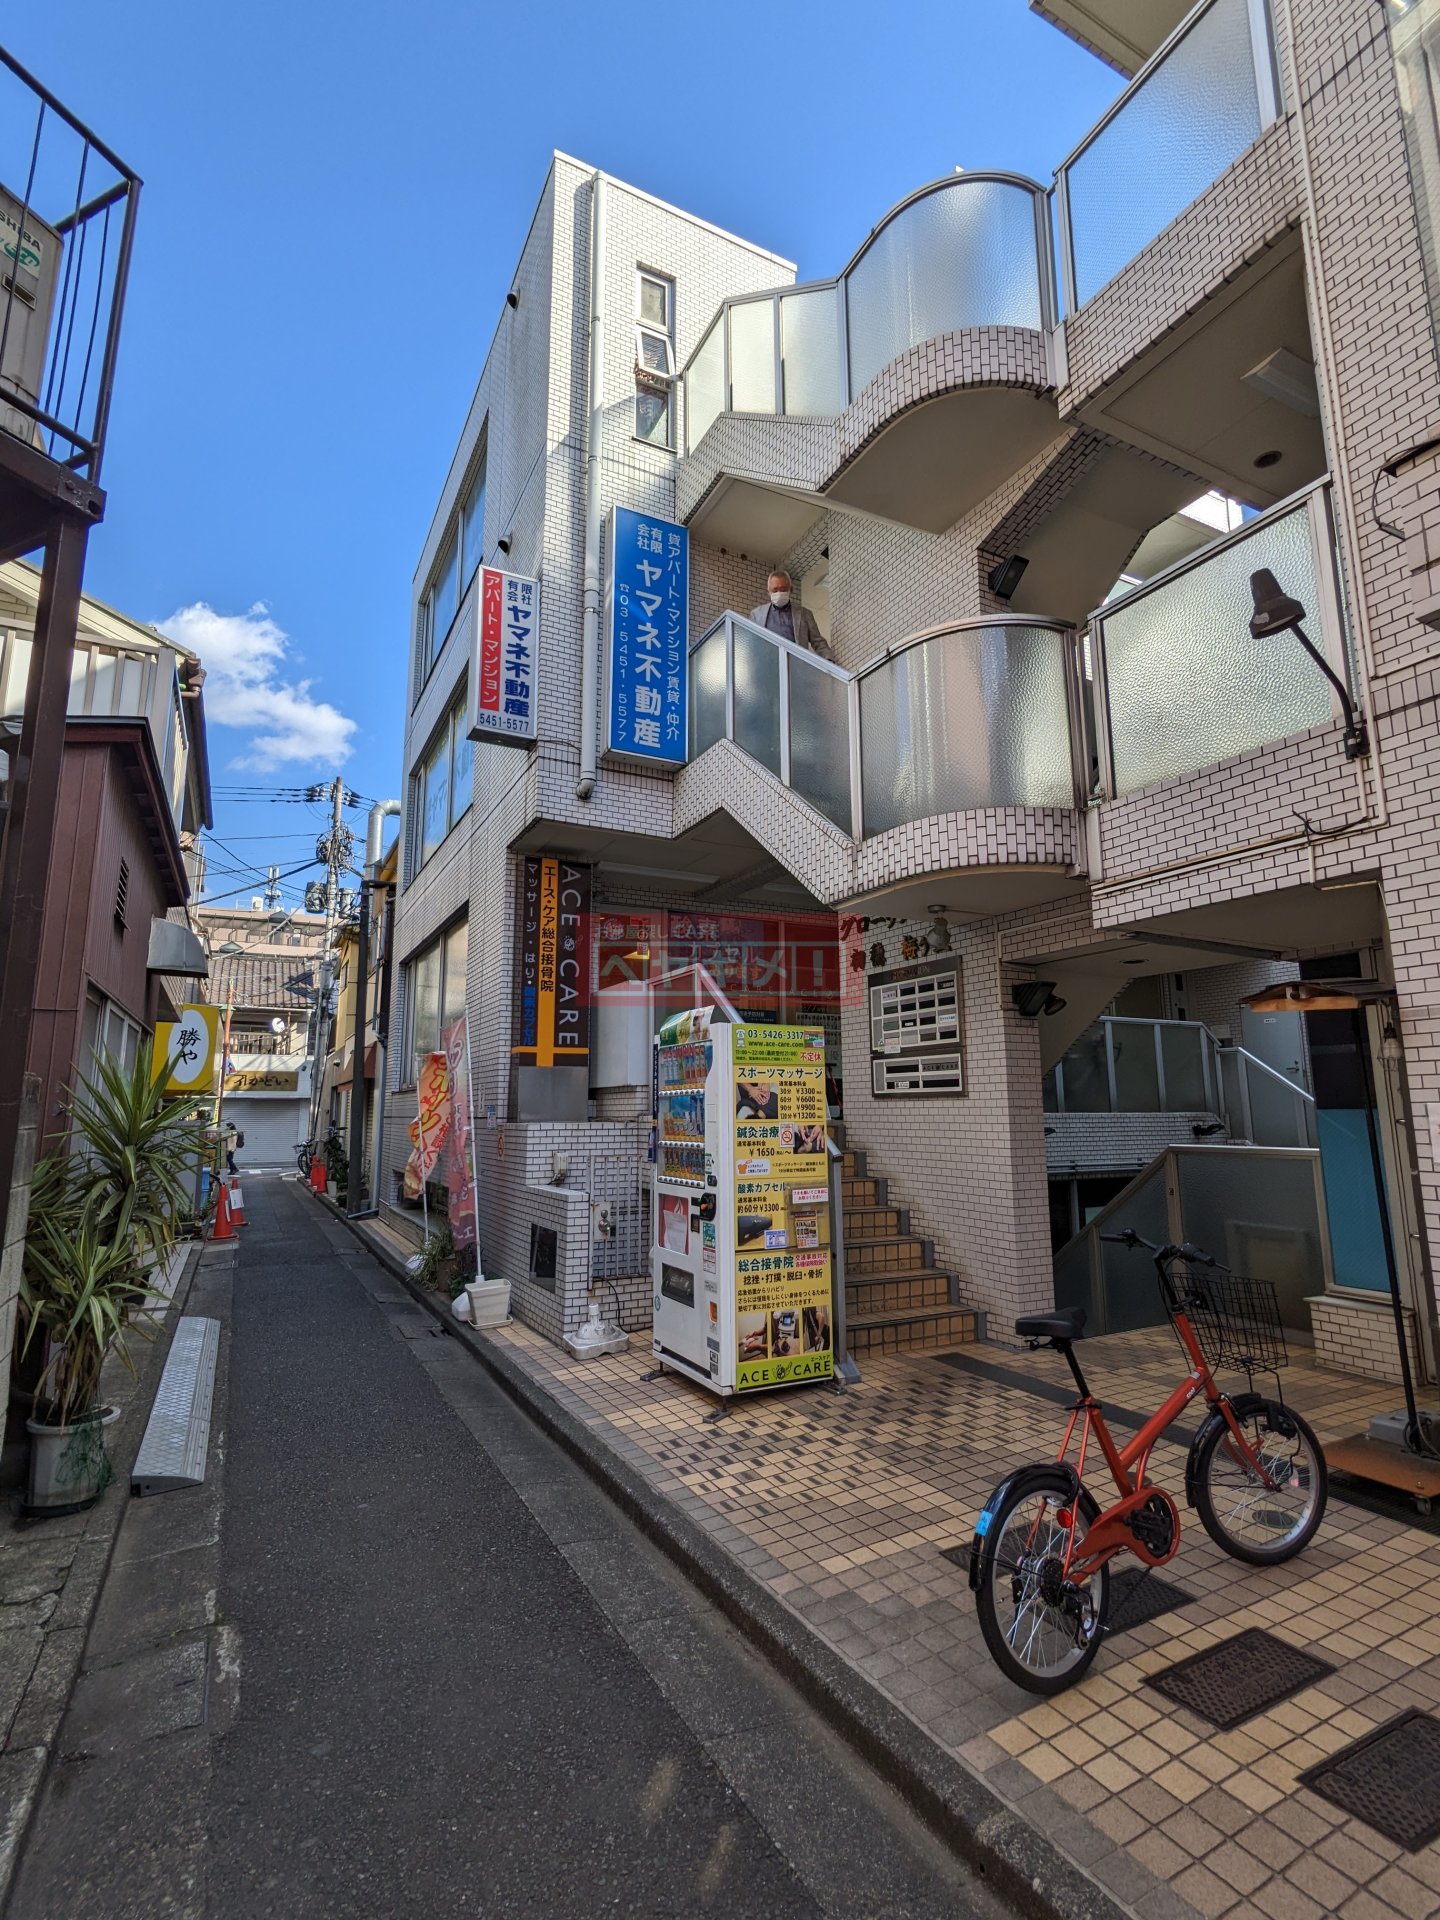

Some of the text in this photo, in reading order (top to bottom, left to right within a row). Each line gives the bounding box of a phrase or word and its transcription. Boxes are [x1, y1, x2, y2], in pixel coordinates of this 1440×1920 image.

[482, 575, 501, 703] アパート・マンション
[503, 605, 532, 718] ヤマネ不動産
[634, 559, 662, 749] ヤマネ不動産
[480, 712, 530, 732] 5451-5577
[540, 866, 557, 992] エース・ケア総合接骨院
[558, 865, 582, 1045] ACE CARE
[748, 1029, 804, 1040] 03-5426-3317
[748, 1040, 804, 1048] www.ace-care.com
[176, 1027, 201, 1065] 勝や
[800, 1051, 821, 1061] 不定休
[738, 1067, 823, 1079] スポーツマッサージ
[737, 1182, 786, 1194] 酸素カプセル
[738, 1256, 794, 1272] 総合接骨院
[740, 1360, 831, 1384] ACE CARE
